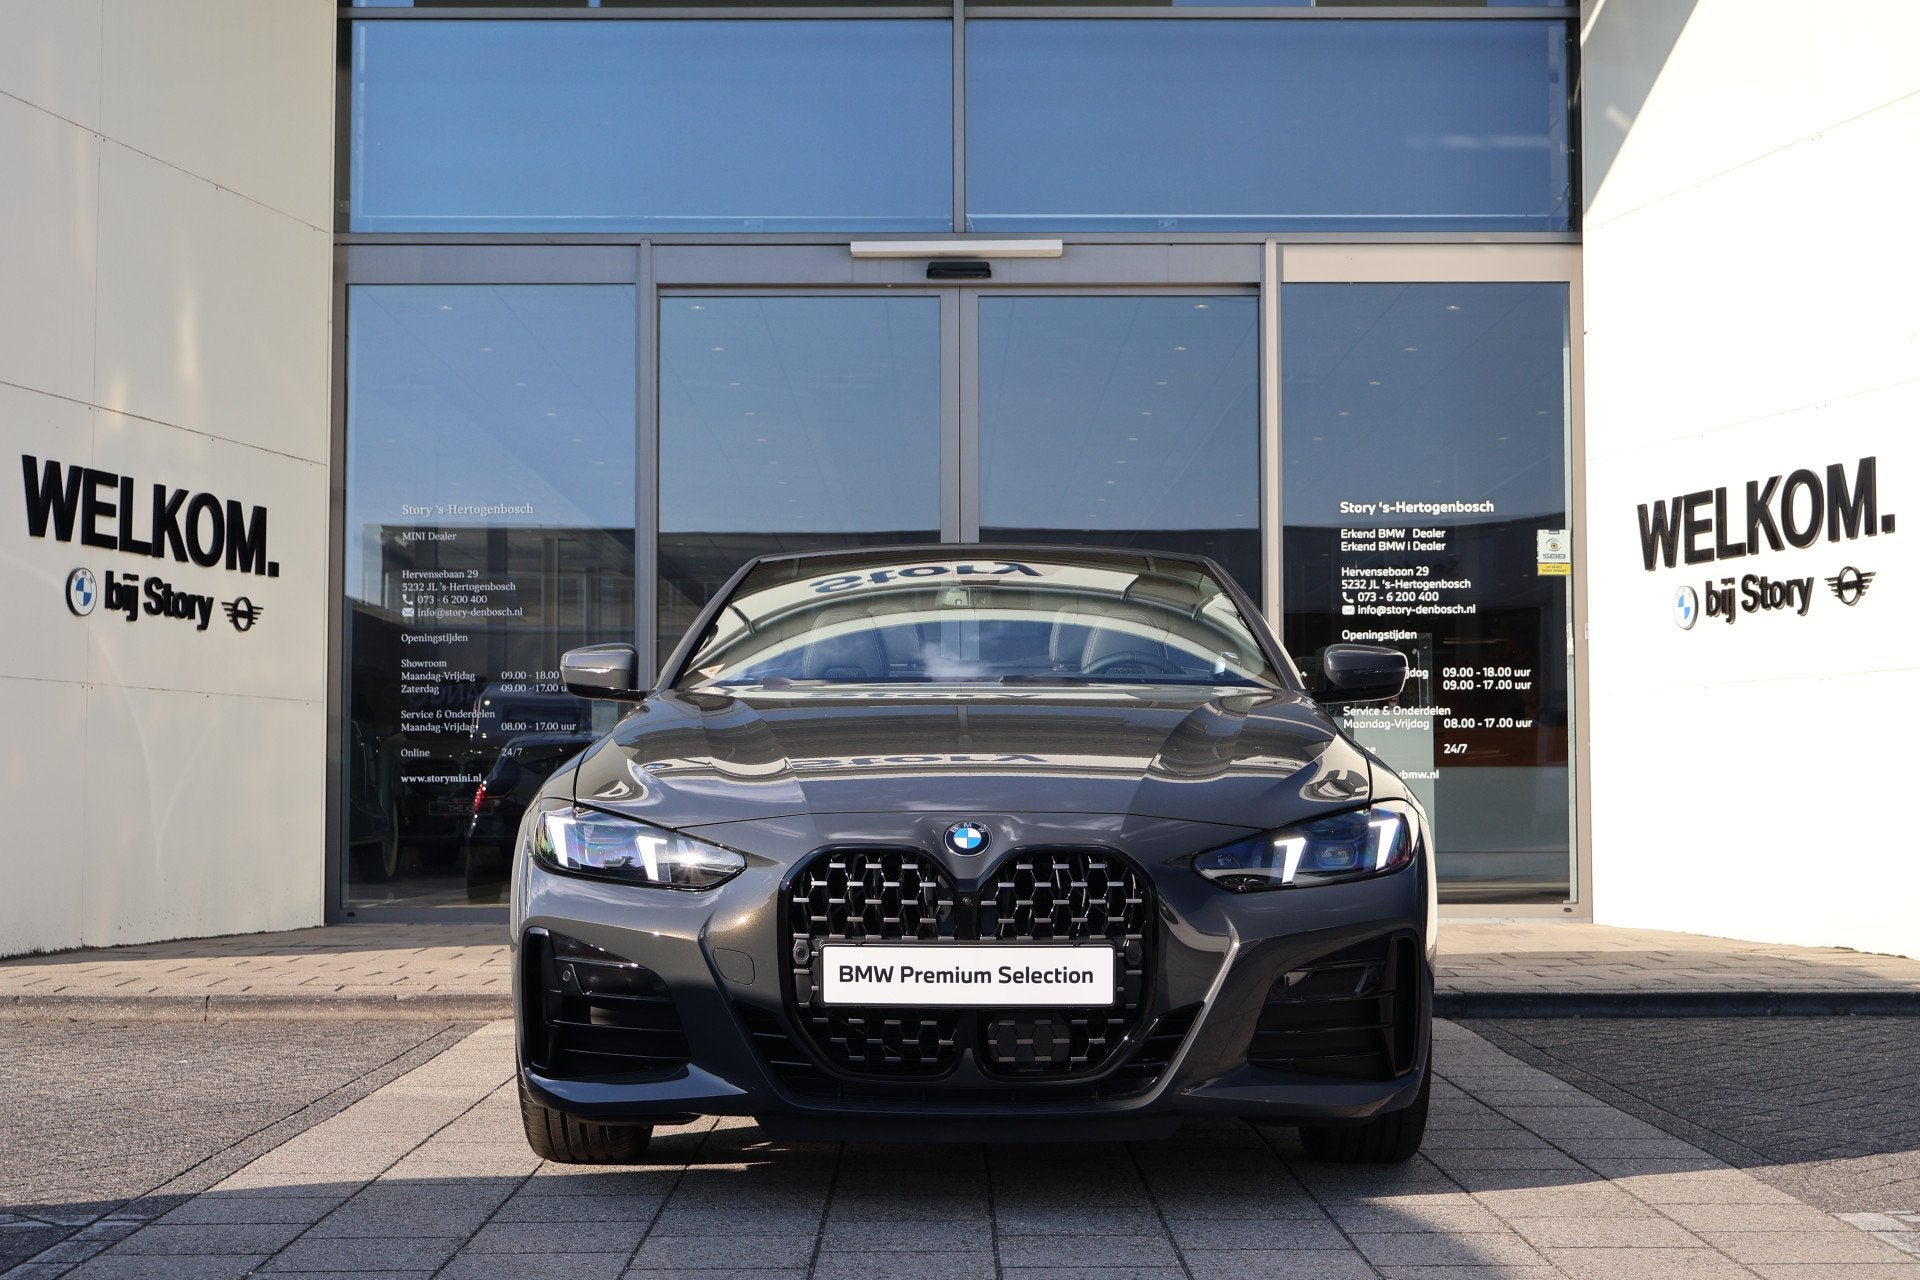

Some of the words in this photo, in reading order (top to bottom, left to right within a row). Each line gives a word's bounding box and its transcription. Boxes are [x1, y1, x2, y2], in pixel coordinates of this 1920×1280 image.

[402, 504, 432, 517] Story
[1339, 501, 1376, 516] Story
[1637, 456, 1895, 571] WELKOM.
[22, 454, 279, 577] WELKOM.
[402, 531, 426, 541] MINI
[428, 531, 457, 541] Dealer
[1340, 528, 1376, 539] Erkend
[1378, 528, 1406, 539] BMW
[1412, 528, 1446, 539] Dealer
[1340, 541, 1376, 552] Erkend
[1378, 541, 1406, 552] BMW
[1412, 541, 1447, 552] Dealer
[402, 569, 465, 579] Hervensebaan
[467, 569, 479, 579] 29
[1341, 566, 1414, 577] Hervensebaan
[1415, 566, 1430, 577] 29
[402, 582, 425, 592] 5232
[426, 582, 438, 592] JL
[1341, 579, 1367, 590] 5232
[1368, 579, 1380, 590] JL
[105, 570, 139, 622] bij
[144, 576, 214, 630] Story
[417, 595, 435, 604] 073
[442, 595, 449, 604] 6
[450, 595, 469, 604] 200
[470, 595, 488, 604] 400
[1357, 592, 1377, 602] 073
[1386, 592, 1393, 602] 6
[1395, 592, 1417, 602] 200
[1418, 591, 1440, 602] 400
[1705, 577, 1736, 624] bij
[1741, 573, 1814, 616] Story
[417, 607, 524, 619] info@story-denbosch.nl
[1357, 604, 1476, 617] info@story-denbosch.nl
[401, 633, 469, 643] Openingstijden
[1341, 630, 1418, 641] Openingstijden
[401, 659, 447, 668] Showroom
[401, 671, 476, 682] Maandag-Vrijdag
[501, 671, 527, 680] 09.00
[535, 671, 560, 680] 18.00
[1442, 667, 1474, 677] 09.00
[1483, 667, 1512, 677] 18.00
[1513, 669, 1531, 677] uur
[401, 684, 440, 695] Zaterdag
[501, 684, 527, 693] 09.00
[535, 684, 559, 693] 17.00
[1443, 680, 1474, 690] 09.00
[1514, 682, 1531, 690] uur
[401, 710, 433, 719] Service
[435, 710, 443, 719] &
[444, 709, 496, 719] Onderdelen
[1343, 706, 1380, 716] Service
[1382, 706, 1391, 716] &
[1393, 706, 1451, 716] Onderdelen
[401, 722, 476, 733] Maandag-Vrijdag
[501, 722, 527, 731] 08.00
[535, 722, 559, 731] 17.00
[1343, 719, 1430, 730] Maandag-Vrijdag
[1443, 718, 1475, 728] 08.00
[1515, 720, 1533, 728] uur
[401, 748, 431, 758] Online
[501, 748, 523, 757] 24/7
[1443, 743, 1468, 754] 24/7
[401, 773, 482, 784] www.storymini.nl
[838, 965, 894, 983] BMW
[900, 965, 992, 984] Premium
[998, 965, 1094, 984] Selection
